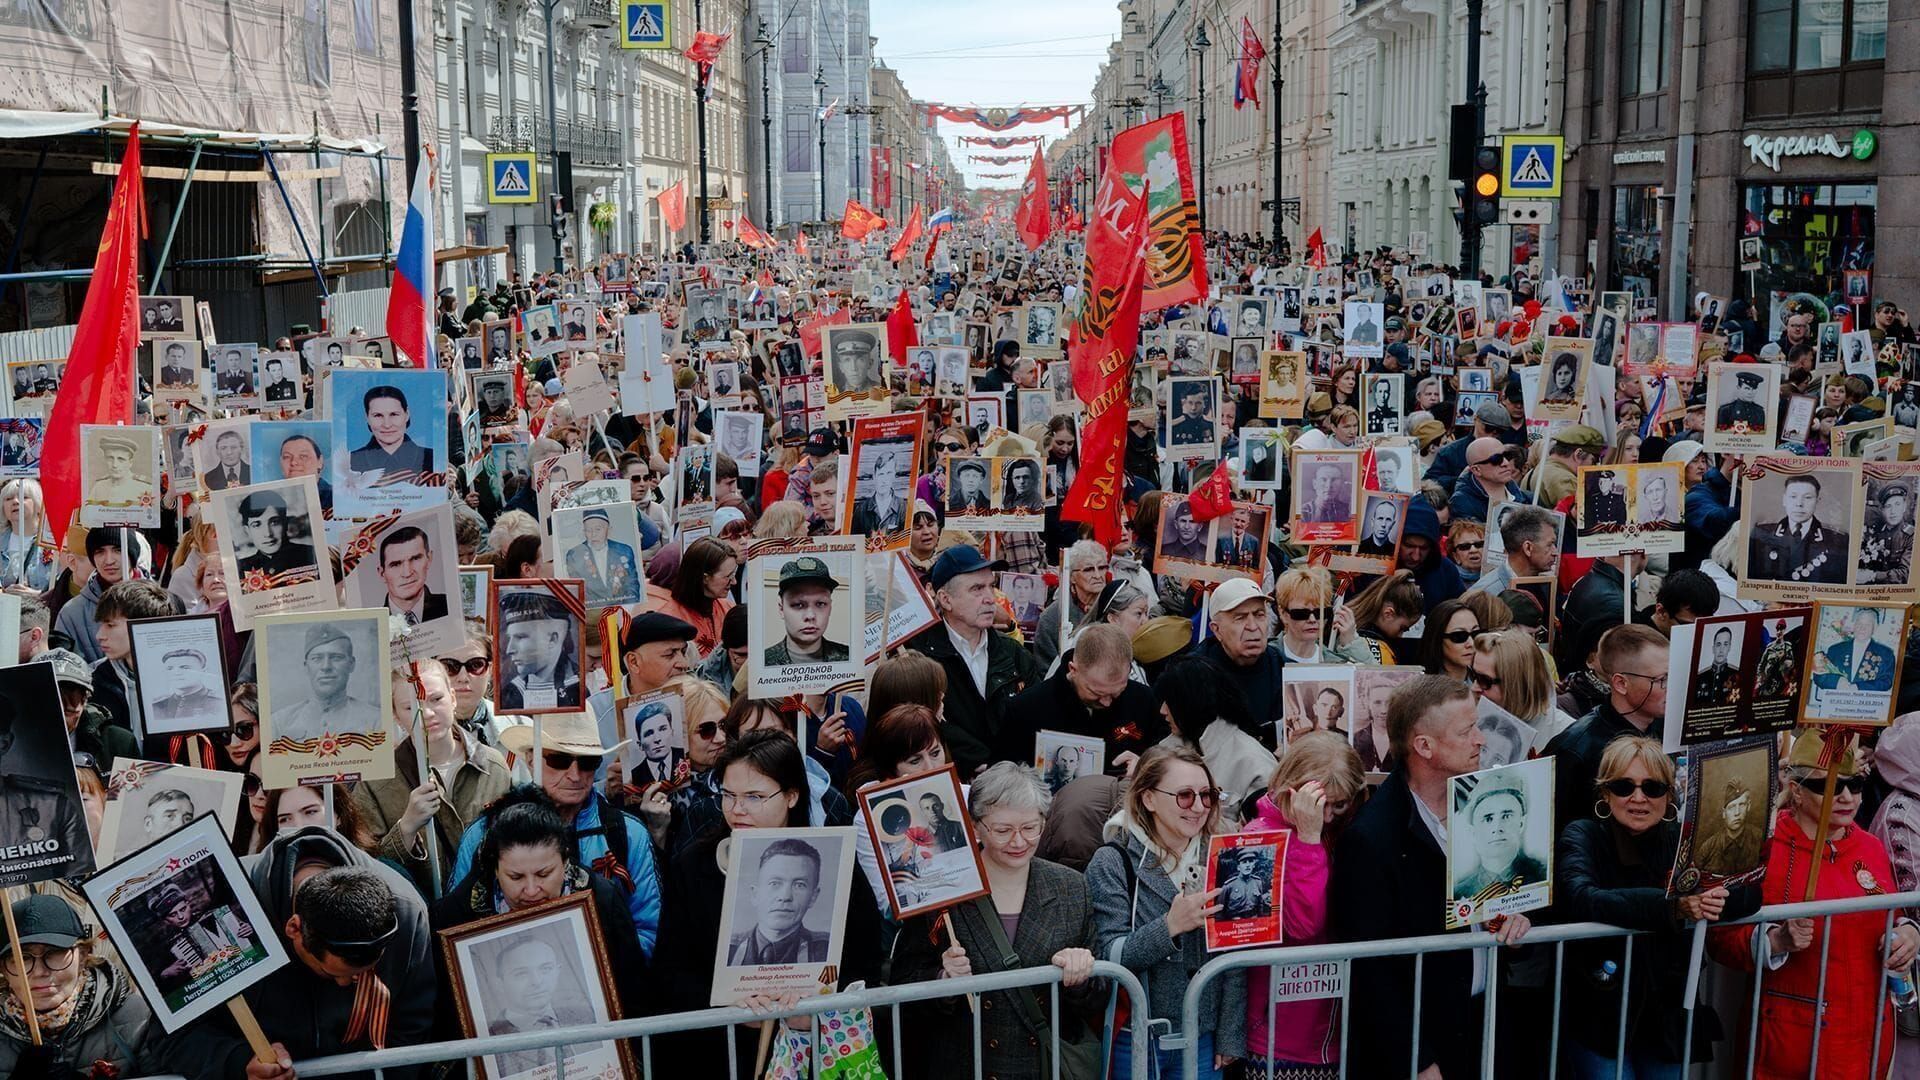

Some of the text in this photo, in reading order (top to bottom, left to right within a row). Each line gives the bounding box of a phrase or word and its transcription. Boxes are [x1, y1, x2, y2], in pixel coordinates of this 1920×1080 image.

[1826, 459, 1850, 468] ПОЛК
[781, 665, 833, 676] КОРОЛЬКОВ
[757, 672, 857, 687] Александр Викторович
[740, 974, 772, 983] Владимир
